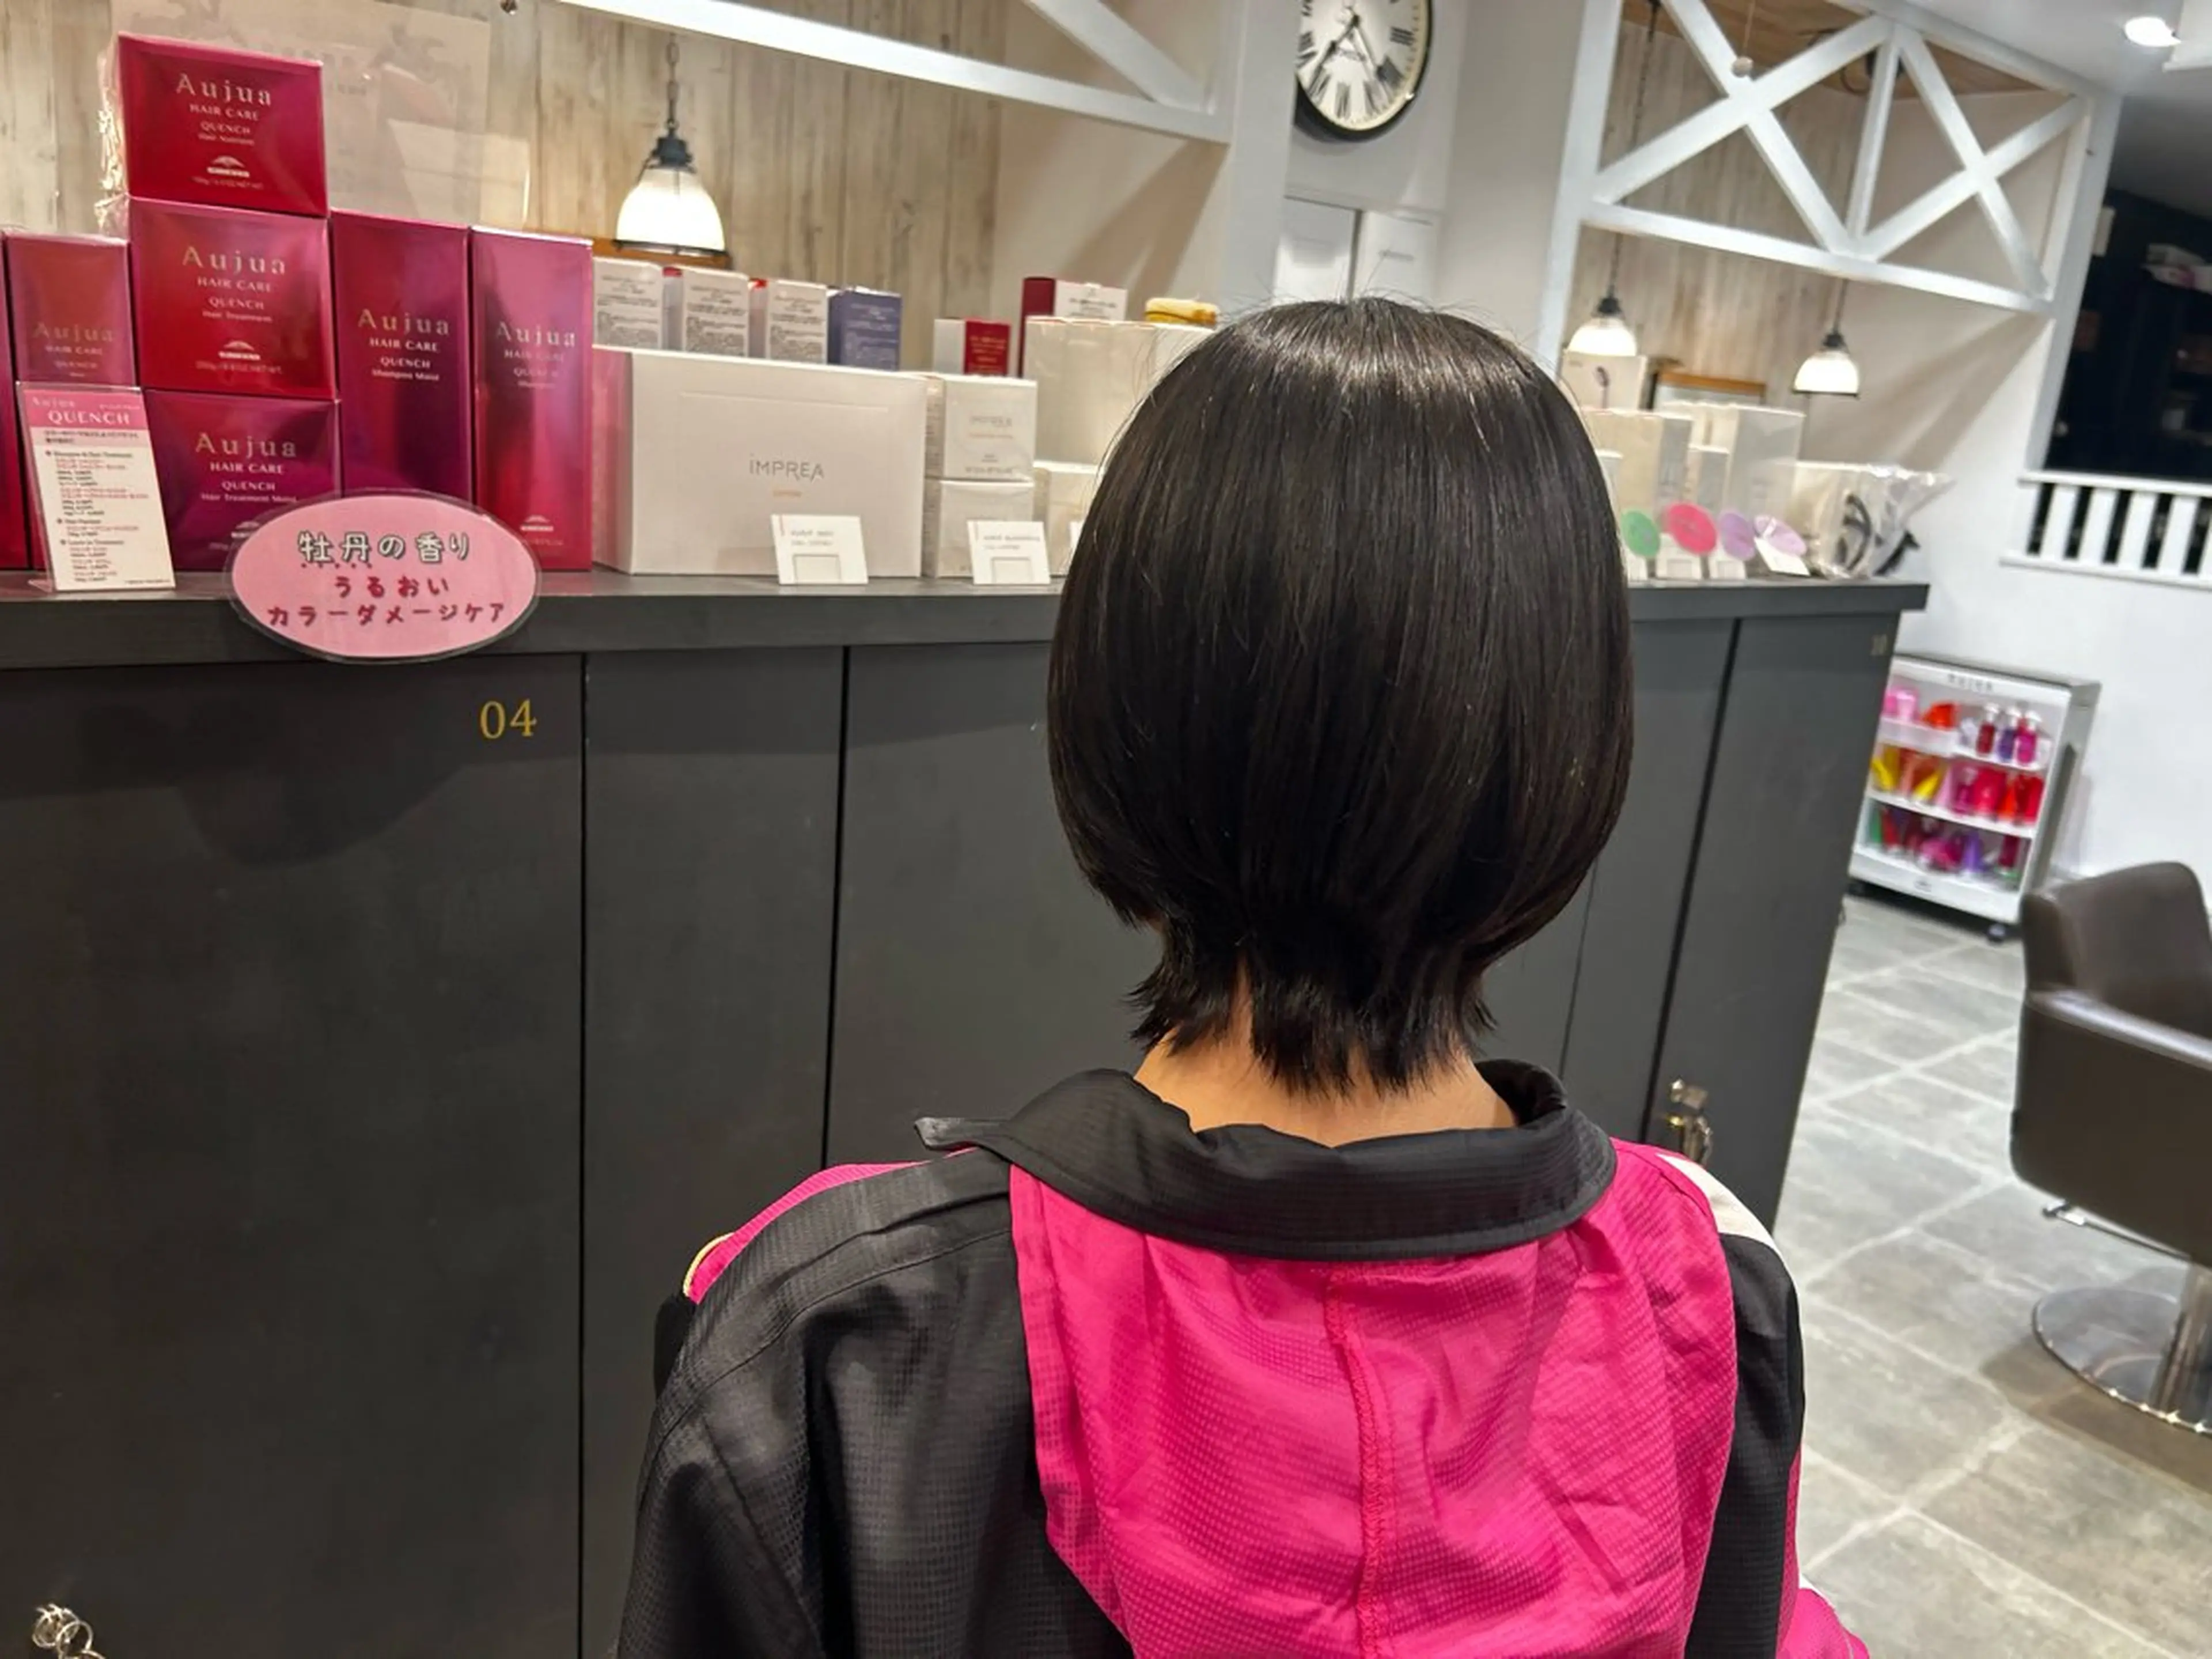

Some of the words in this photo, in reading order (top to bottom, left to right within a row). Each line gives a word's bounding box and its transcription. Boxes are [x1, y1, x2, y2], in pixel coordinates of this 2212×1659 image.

[176, 73, 271, 106] Aujua
[190, 104, 221, 116] HAIR
[225, 108, 259, 121] CARE
[200, 122, 251, 134] QUENCH
[182, 246, 285, 275] Aujua
[197, 276, 232, 289] HAIR
[236, 280, 271, 293] CARE
[208, 297, 264, 310] QUENCH
[33, 321, 114, 342] Aujua
[358, 308, 450, 336] Aujua
[369, 337, 402, 349] HAIR
[406, 340, 440, 353] CARE
[496, 321, 575, 348] Aujua
[381, 355, 431, 369] QUENCH
[48, 410, 131, 425] QUENCH
[196, 433, 296, 459] Aujua
[210, 462, 243, 473] HAIR
[248, 464, 284, 475] CARE
[222, 480, 276, 491] QUENCH
[298, 530, 469, 563] 牡丹の香り
[335, 575, 449, 598] うるおい
[267, 603, 505, 627] カラーダメージケア
[480, 699, 537, 739] 04
